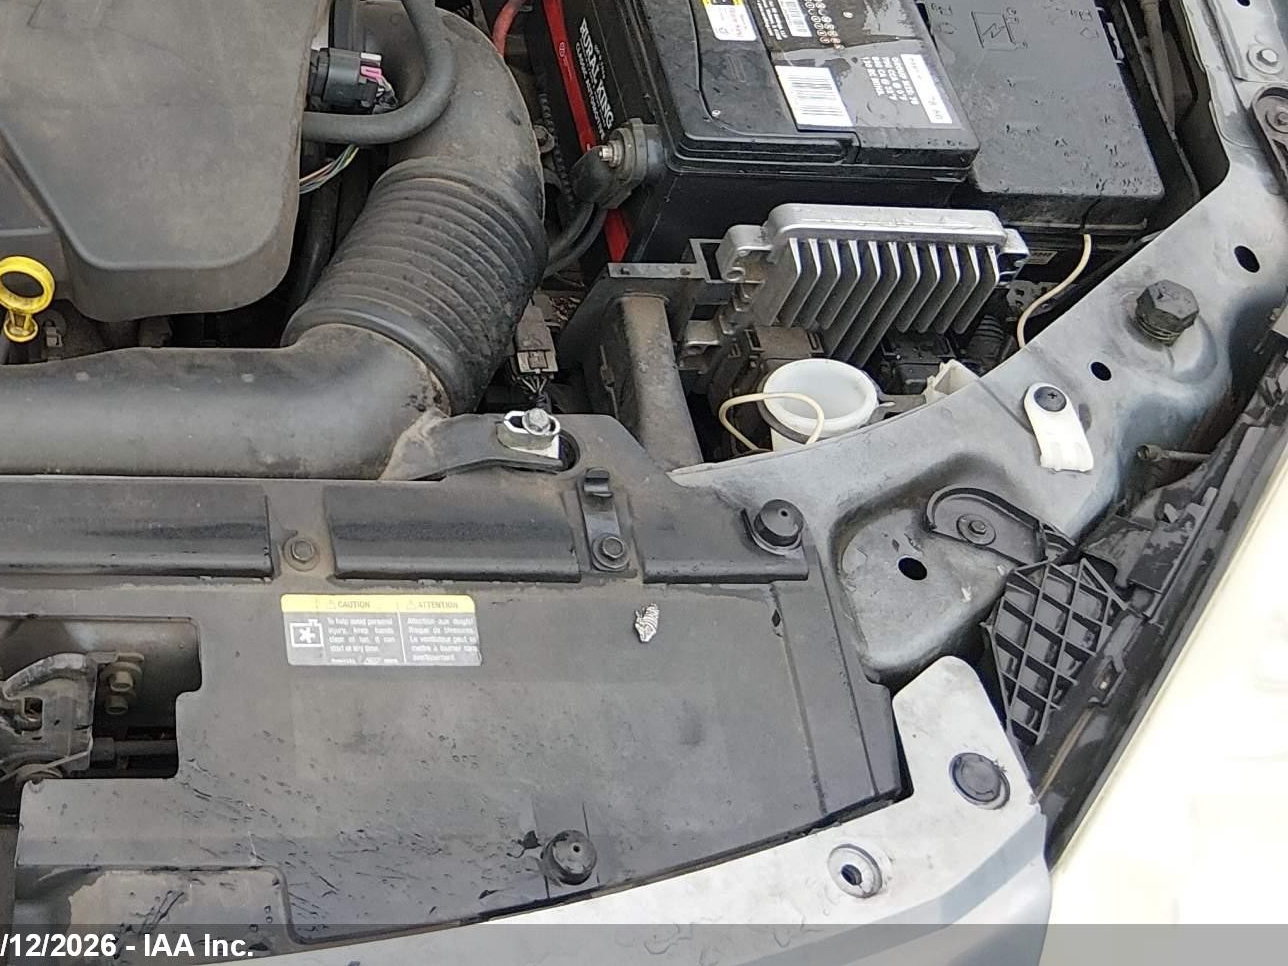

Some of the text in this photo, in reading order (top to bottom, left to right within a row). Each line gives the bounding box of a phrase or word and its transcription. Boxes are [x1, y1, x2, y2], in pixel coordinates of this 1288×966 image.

[580, 17, 600, 85] RURAL
[596, 78, 614, 130] KING
[877, 68, 887, 78] CA
[887, 68, 900, 82] CCA
[337, 600, 371, 609] CAUTION
[418, 601, 459, 609] ATTENTION
